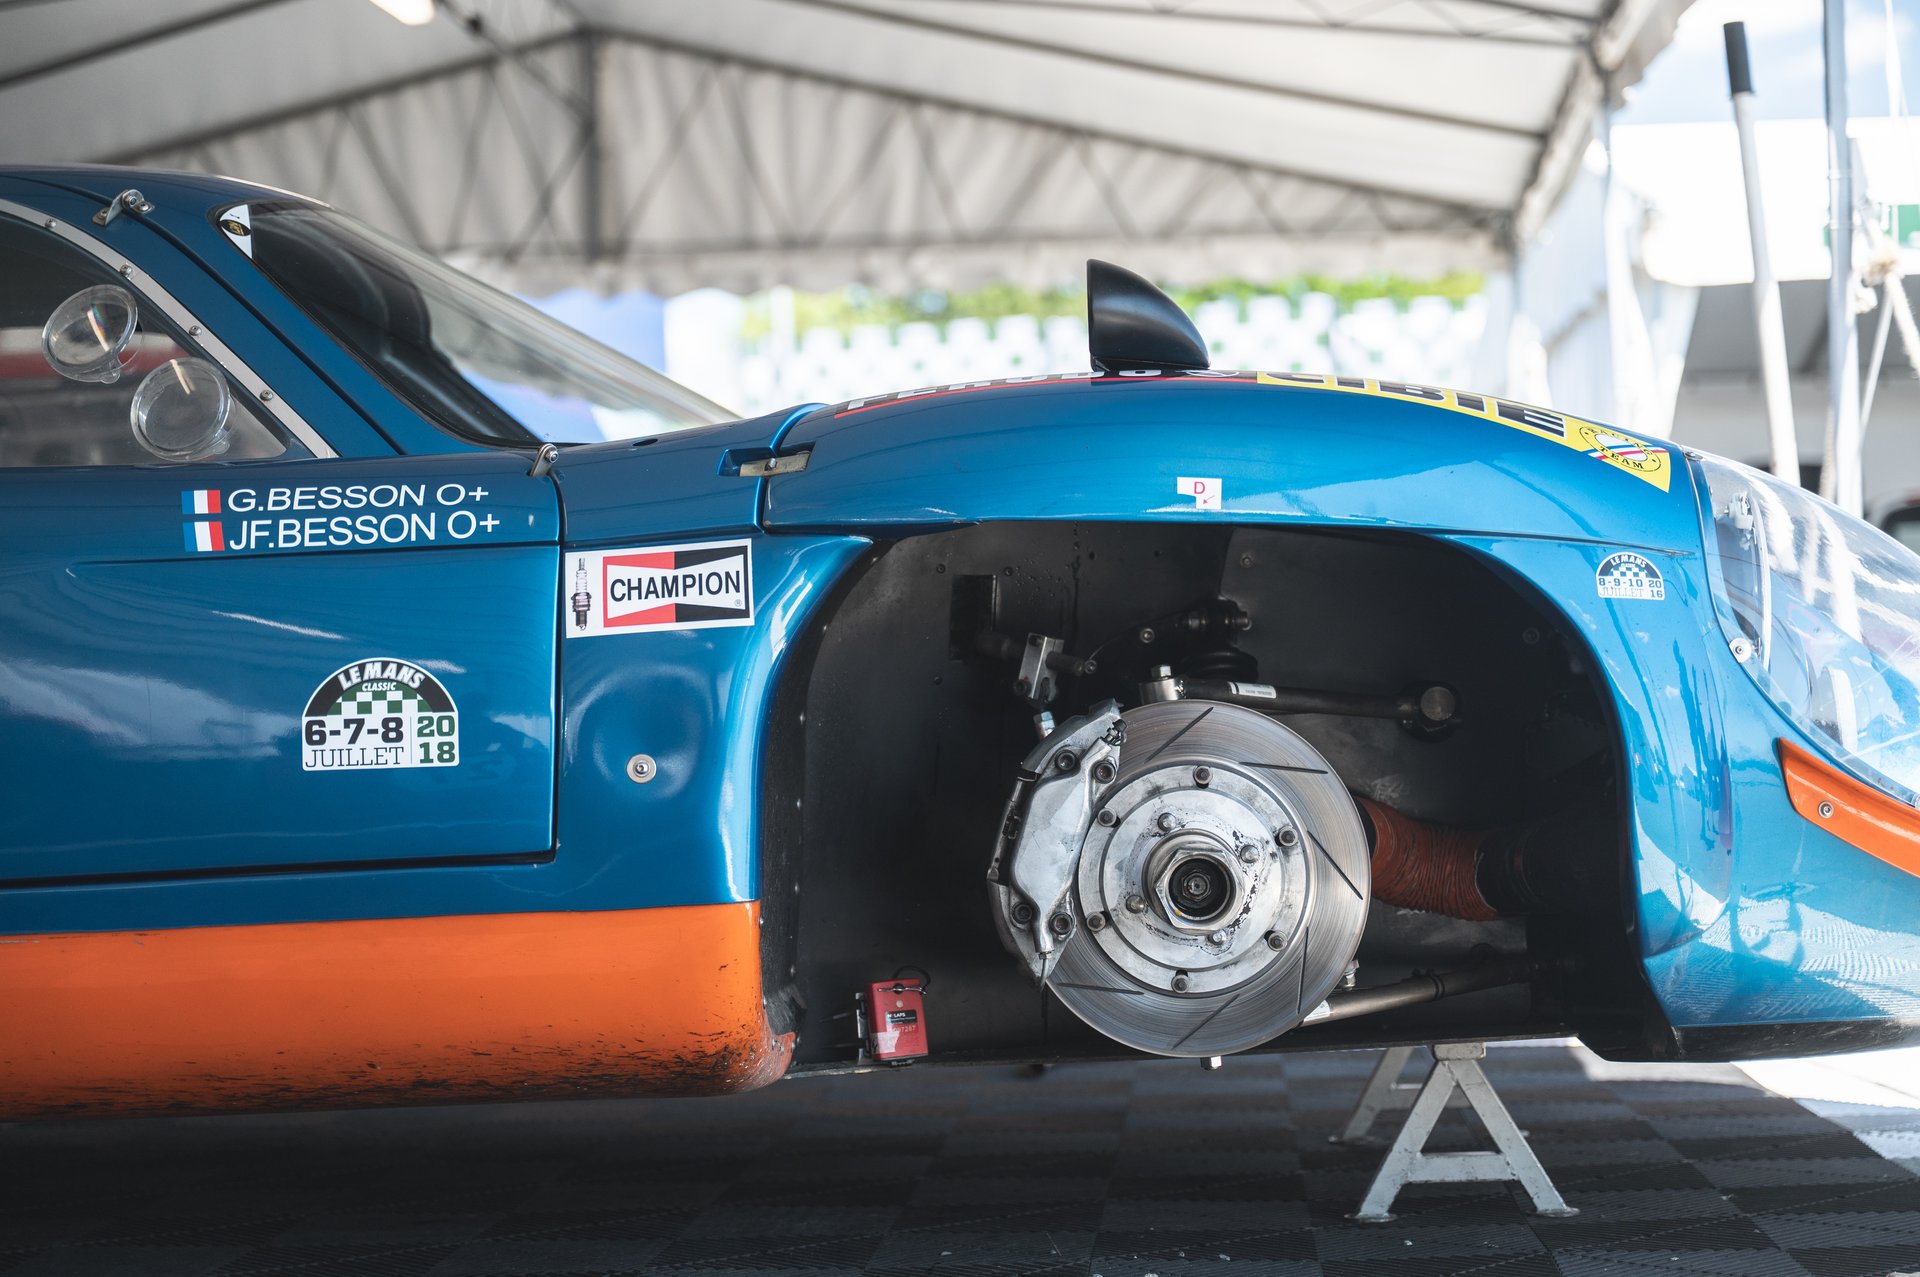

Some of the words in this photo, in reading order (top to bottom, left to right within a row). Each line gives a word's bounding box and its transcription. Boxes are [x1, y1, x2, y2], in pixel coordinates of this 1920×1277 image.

[1600, 446, 1644, 470] TEAM
[227, 484, 426, 513] G.BESSON
[436, 483, 490, 507] O+
[1193, 481, 1206, 495] D
[229, 512, 436, 551] JF.BESSON
[447, 510, 501, 540] O+
[1610, 555, 1620, 566] LE
[1621, 554, 1647, 568] MANS
[610, 570, 741, 602] CHAMPION
[1648, 579, 1662, 589] 20
[1650, 589, 1663, 599] 16
[338, 666, 362, 691] LE
[362, 661, 426, 690] MANS
[361, 681, 397, 692] CLASSIC
[305, 717, 404, 746] 6-7-8
[417, 715, 456, 738] 20
[305, 746, 405, 768] JUILLET
[419, 741, 456, 764] 18
